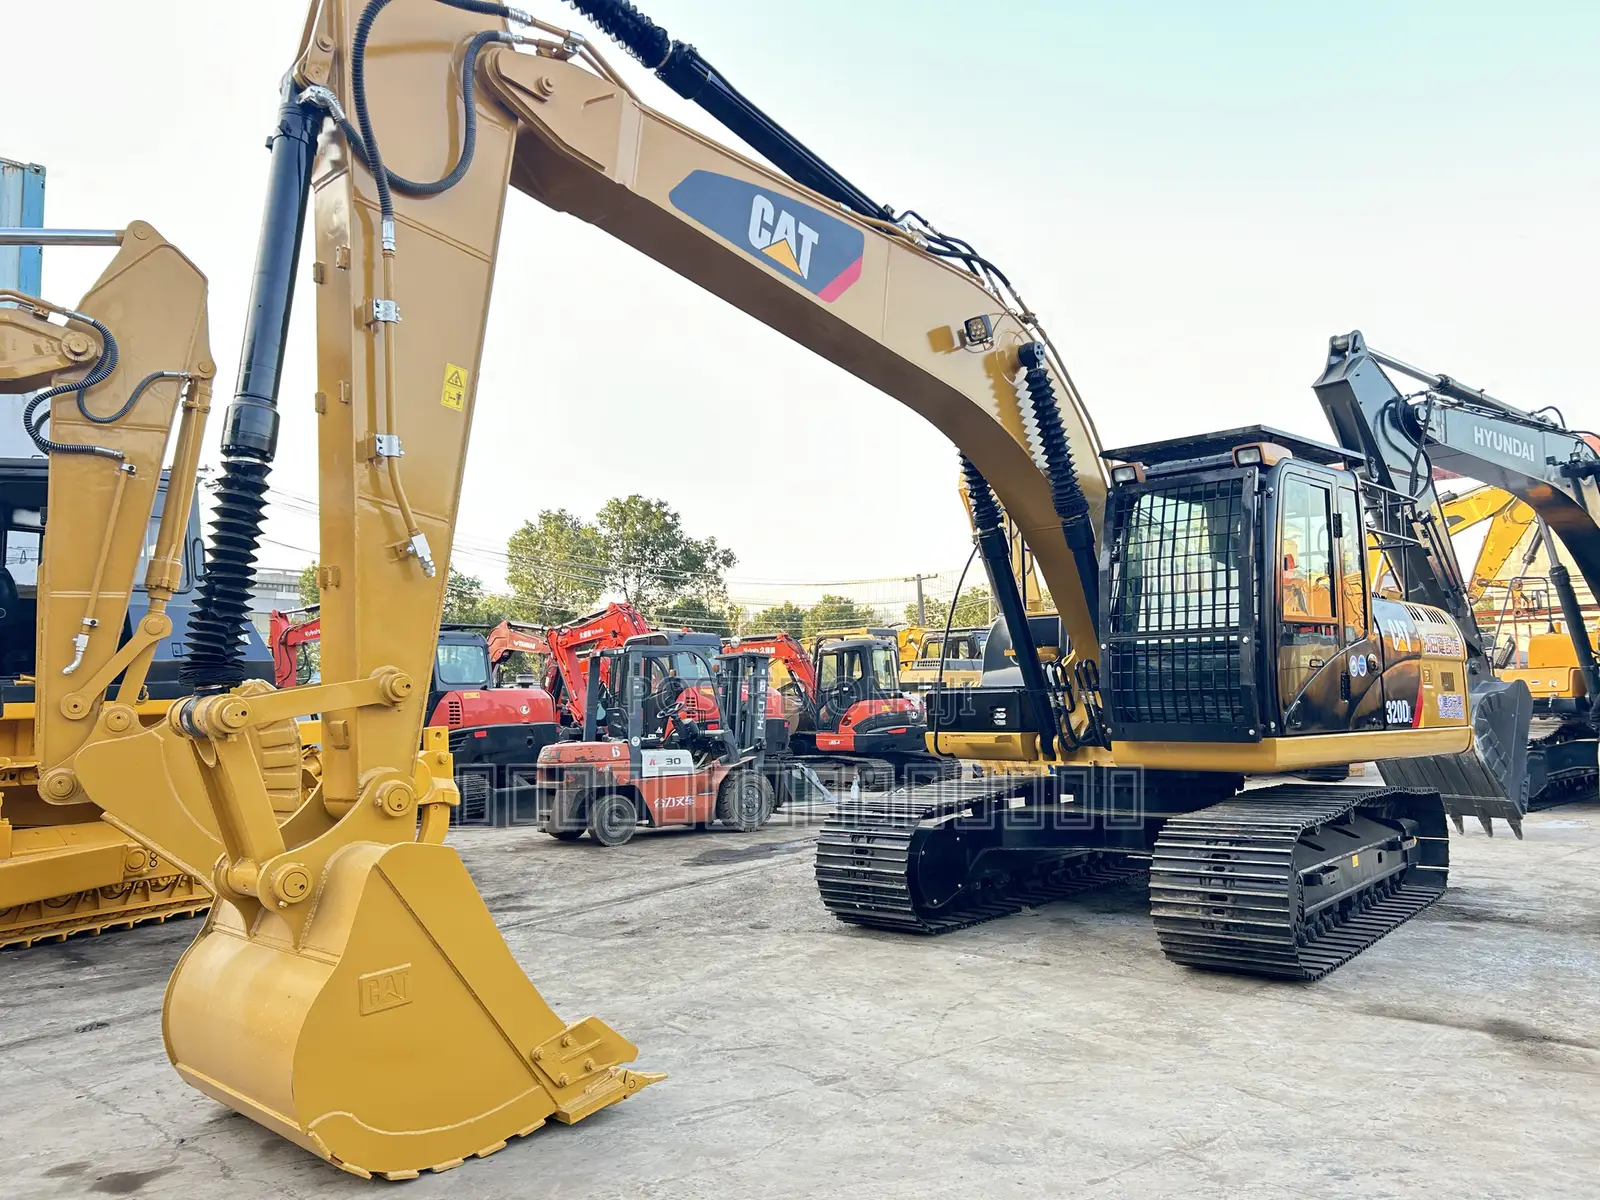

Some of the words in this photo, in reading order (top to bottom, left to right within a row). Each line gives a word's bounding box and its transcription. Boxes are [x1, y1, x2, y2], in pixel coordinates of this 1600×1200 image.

[748, 194, 819, 280] CAT
[1474, 425, 1535, 462] HYUNDAI
[1387, 619, 1412, 653] CAT
[611, 746, 621, 758] 6
[665, 757, 682, 766] 30
[365, 971, 409, 1008] CAT
